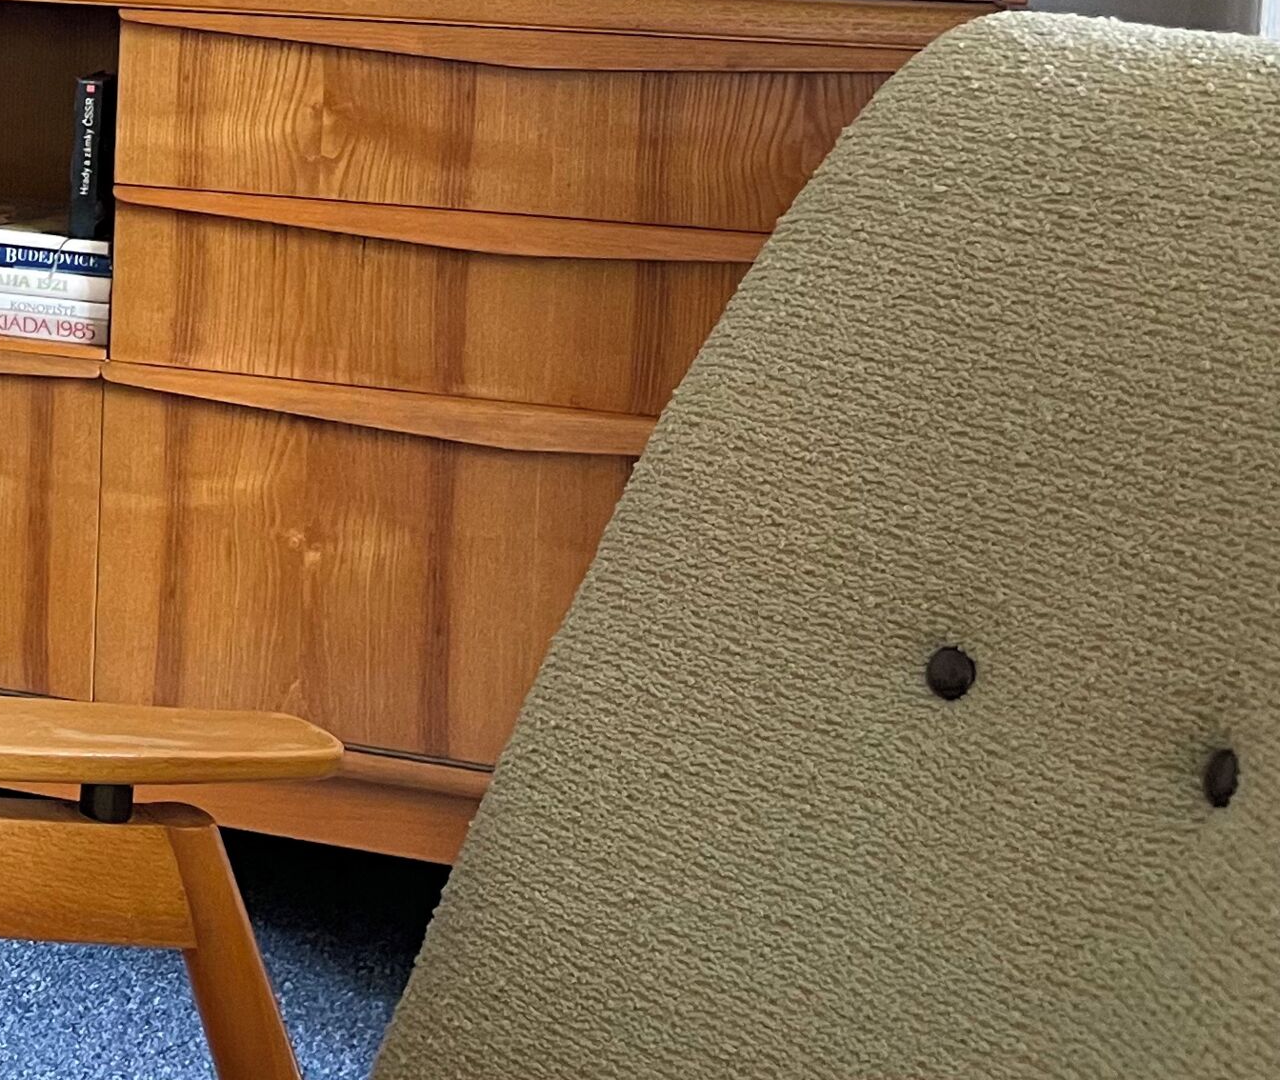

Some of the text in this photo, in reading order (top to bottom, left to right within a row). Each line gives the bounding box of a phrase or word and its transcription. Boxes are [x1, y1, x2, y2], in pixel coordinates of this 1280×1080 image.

[81, 96, 96, 127] ČSSR
[82, 128, 96, 159] zámky
[79, 167, 93, 196] Hrady
[36, 276, 68, 293] 1921
[55, 320, 96, 341] 1985
